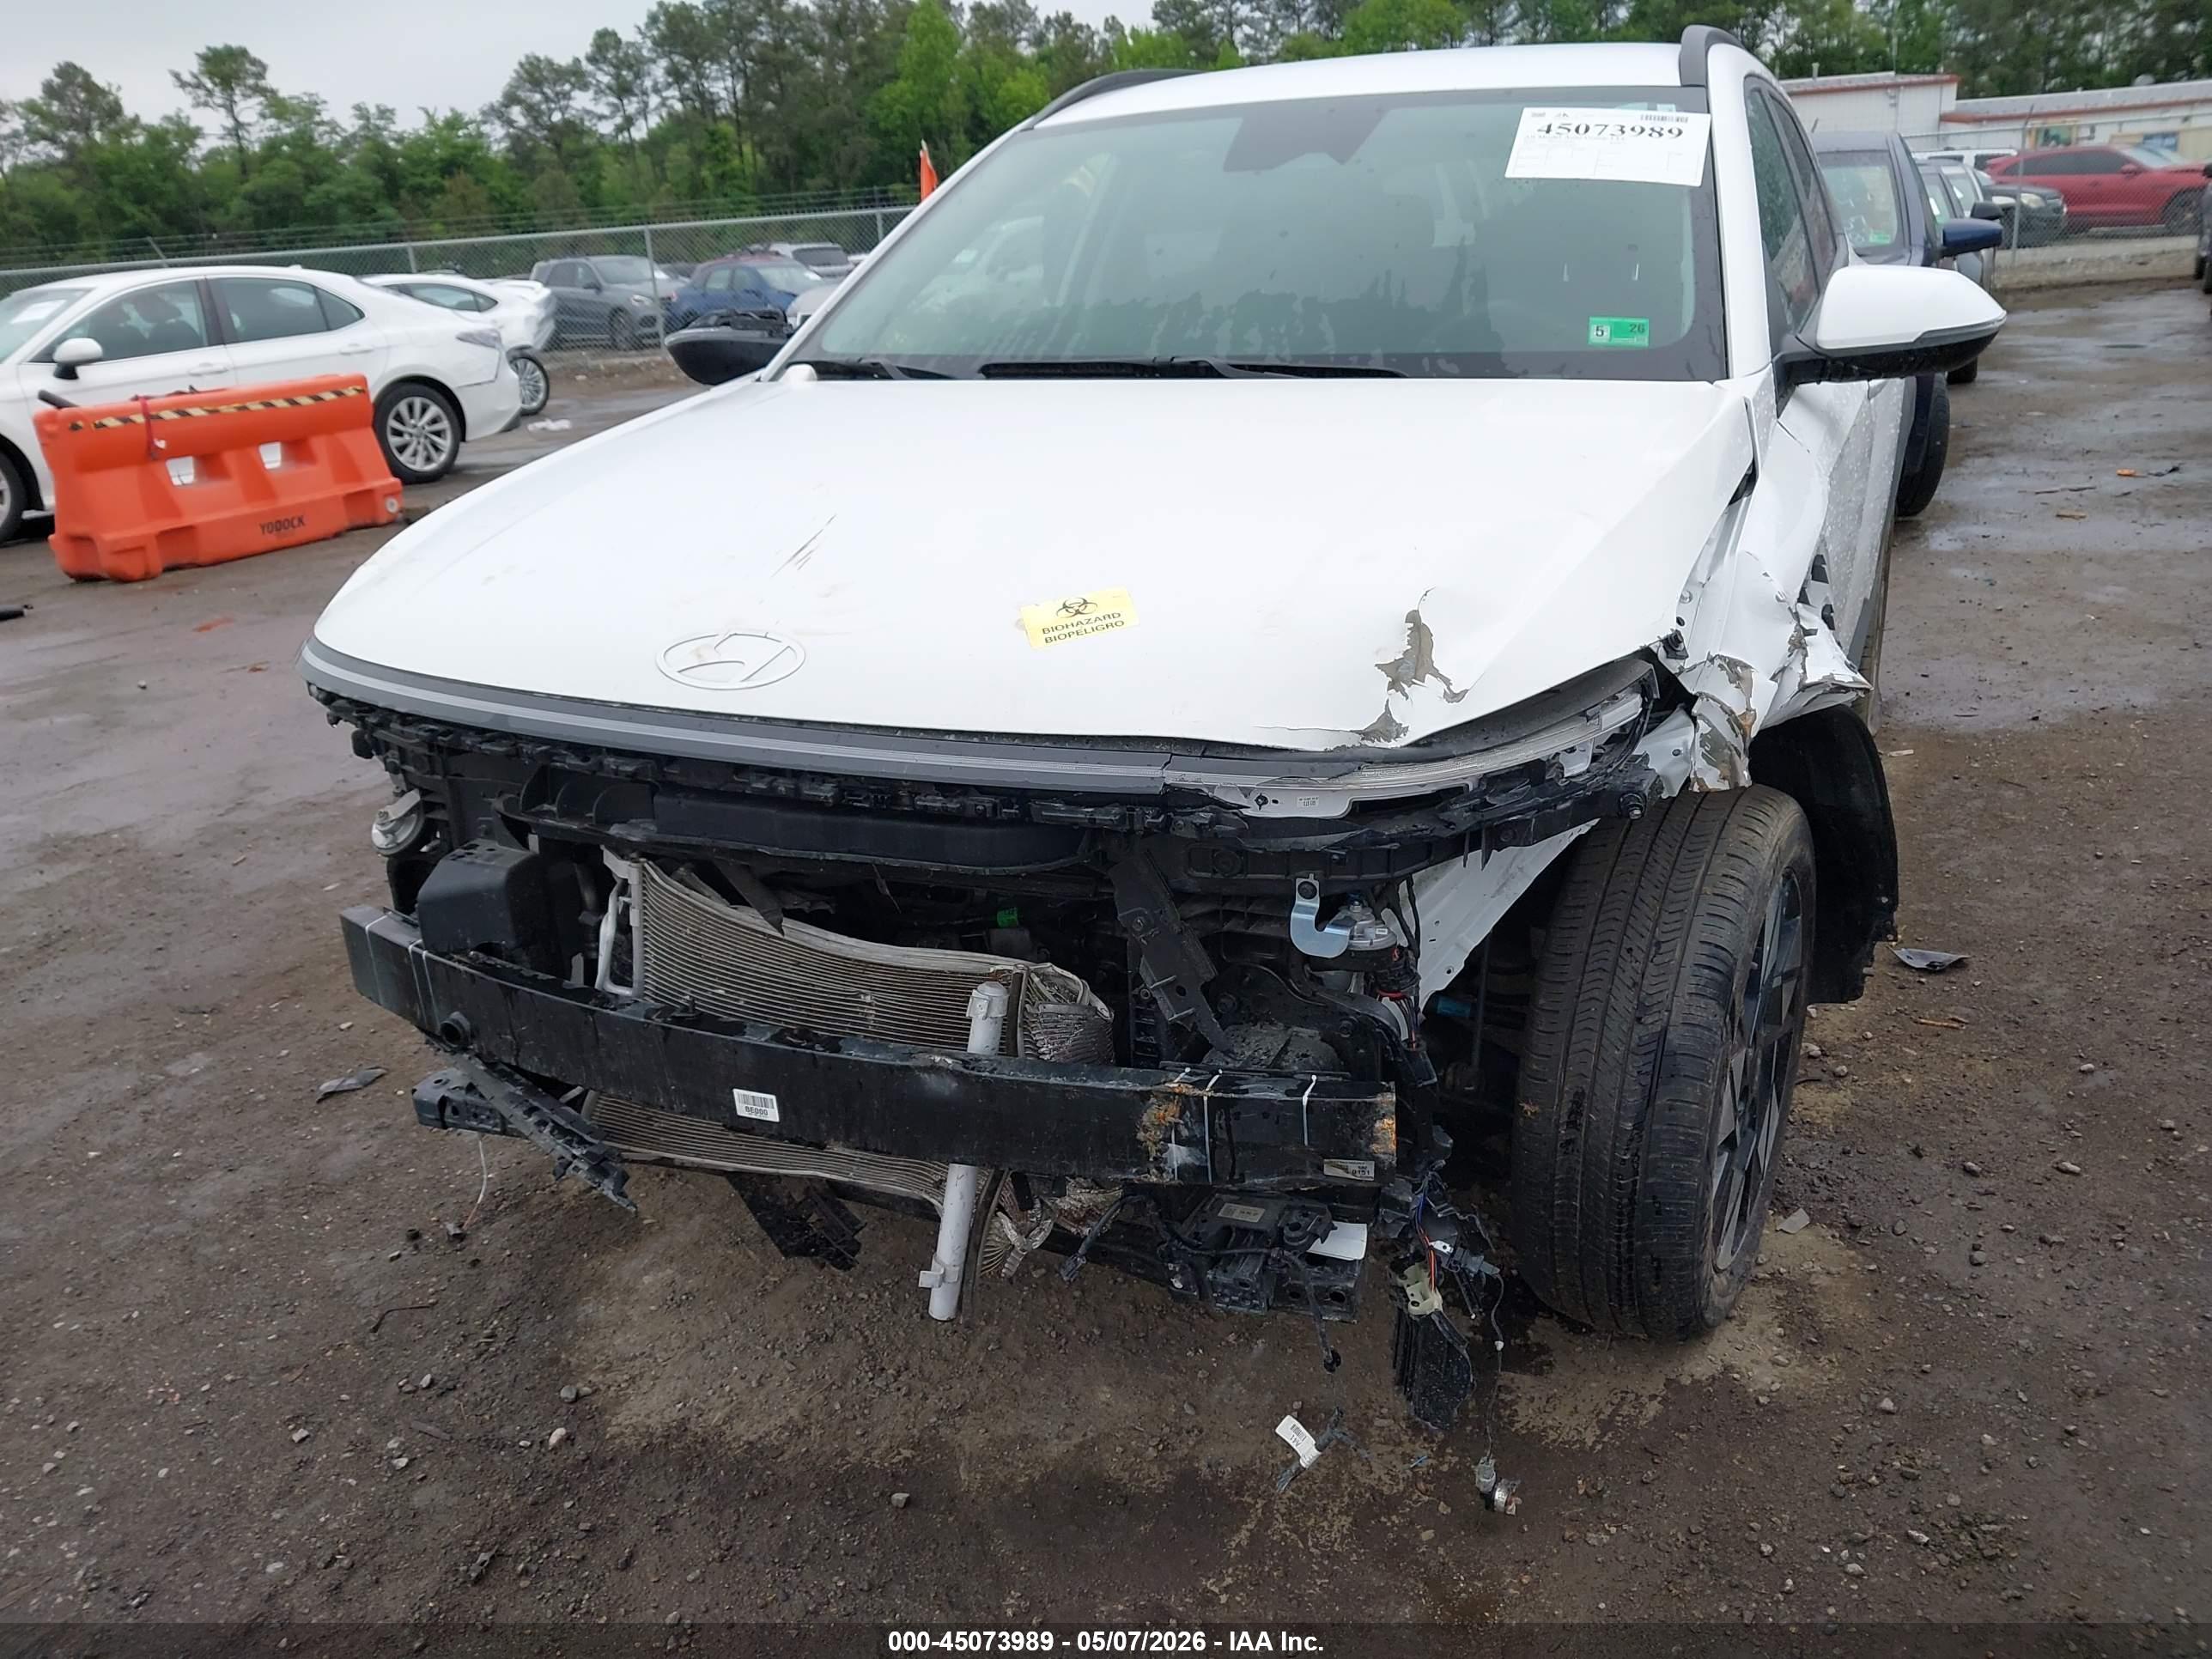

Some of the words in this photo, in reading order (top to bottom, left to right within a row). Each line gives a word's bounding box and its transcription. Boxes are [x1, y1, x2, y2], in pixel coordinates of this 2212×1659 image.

[1536, 122, 1684, 139] 45073989
[1595, 325, 1604, 337] 5
[259, 514, 306, 536] YODOCK
[1042, 611, 1121, 635] BIOHAZARD
[1044, 619, 1125, 644] BIOPELIGRO
